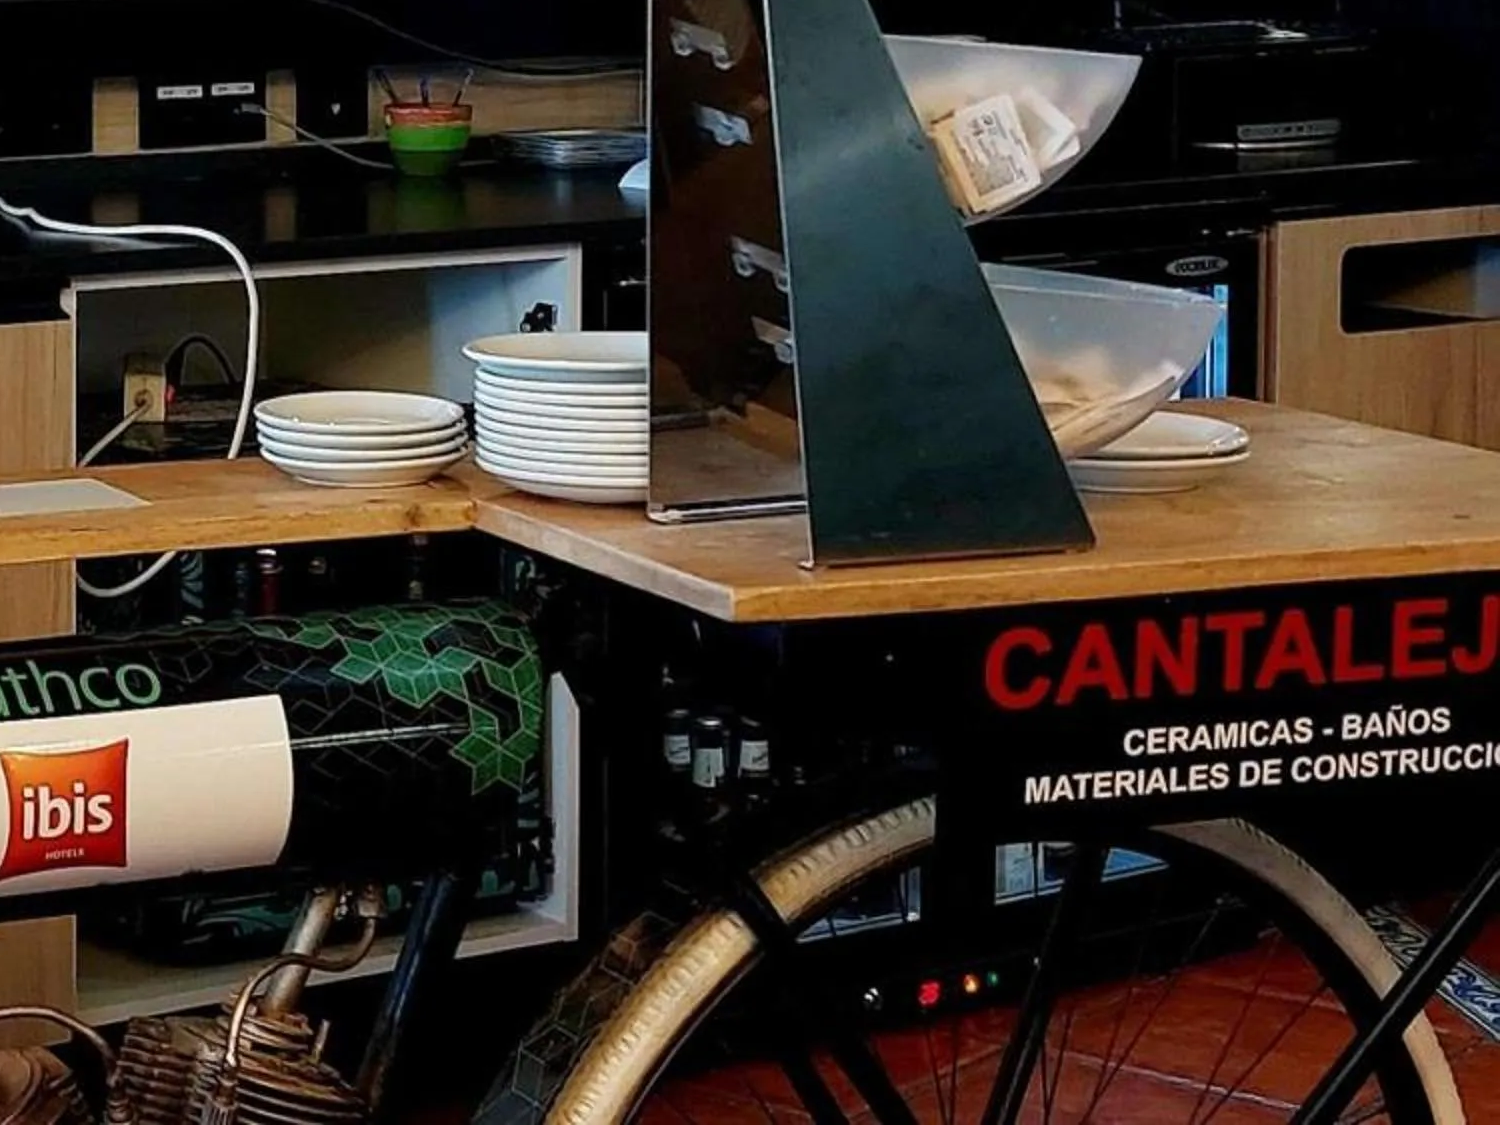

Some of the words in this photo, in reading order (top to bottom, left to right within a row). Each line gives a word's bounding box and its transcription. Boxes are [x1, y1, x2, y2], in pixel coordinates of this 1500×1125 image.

[1122, 716, 1314, 757] CERAMICAS
[1341, 704, 1452, 741] BAÑOS
[1023, 761, 1230, 805] MATERIALES
[1238, 758, 1283, 788] DE
[1290, 741, 1500, 784] CONSTRUCCI
[22, 780, 114, 841] ibis
[45, 846, 85, 861] HOTELS
